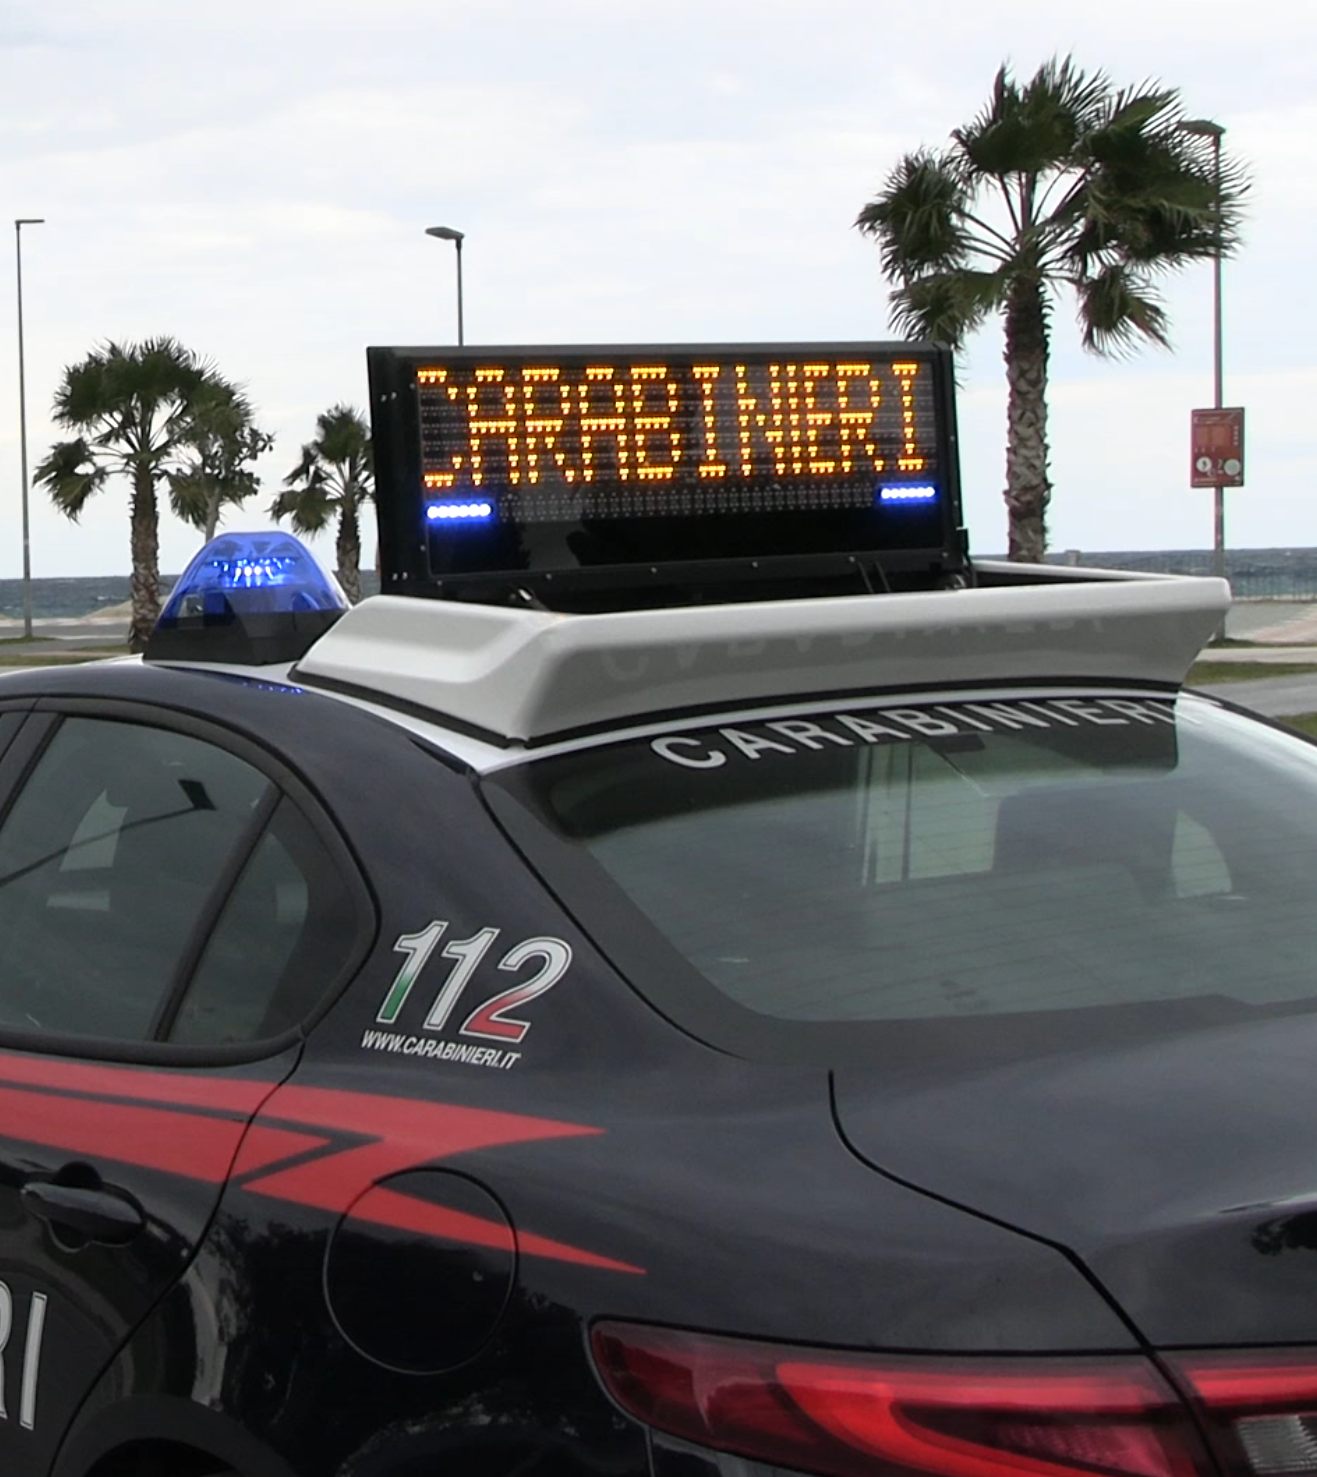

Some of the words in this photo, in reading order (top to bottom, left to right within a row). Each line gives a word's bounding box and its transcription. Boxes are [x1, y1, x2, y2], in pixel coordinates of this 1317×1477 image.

[650, 698, 1201, 770] CARABINIERI
[376, 920, 573, 1043] 112
[361, 1030, 521, 1069] WWW.CARABINIERI.IT
